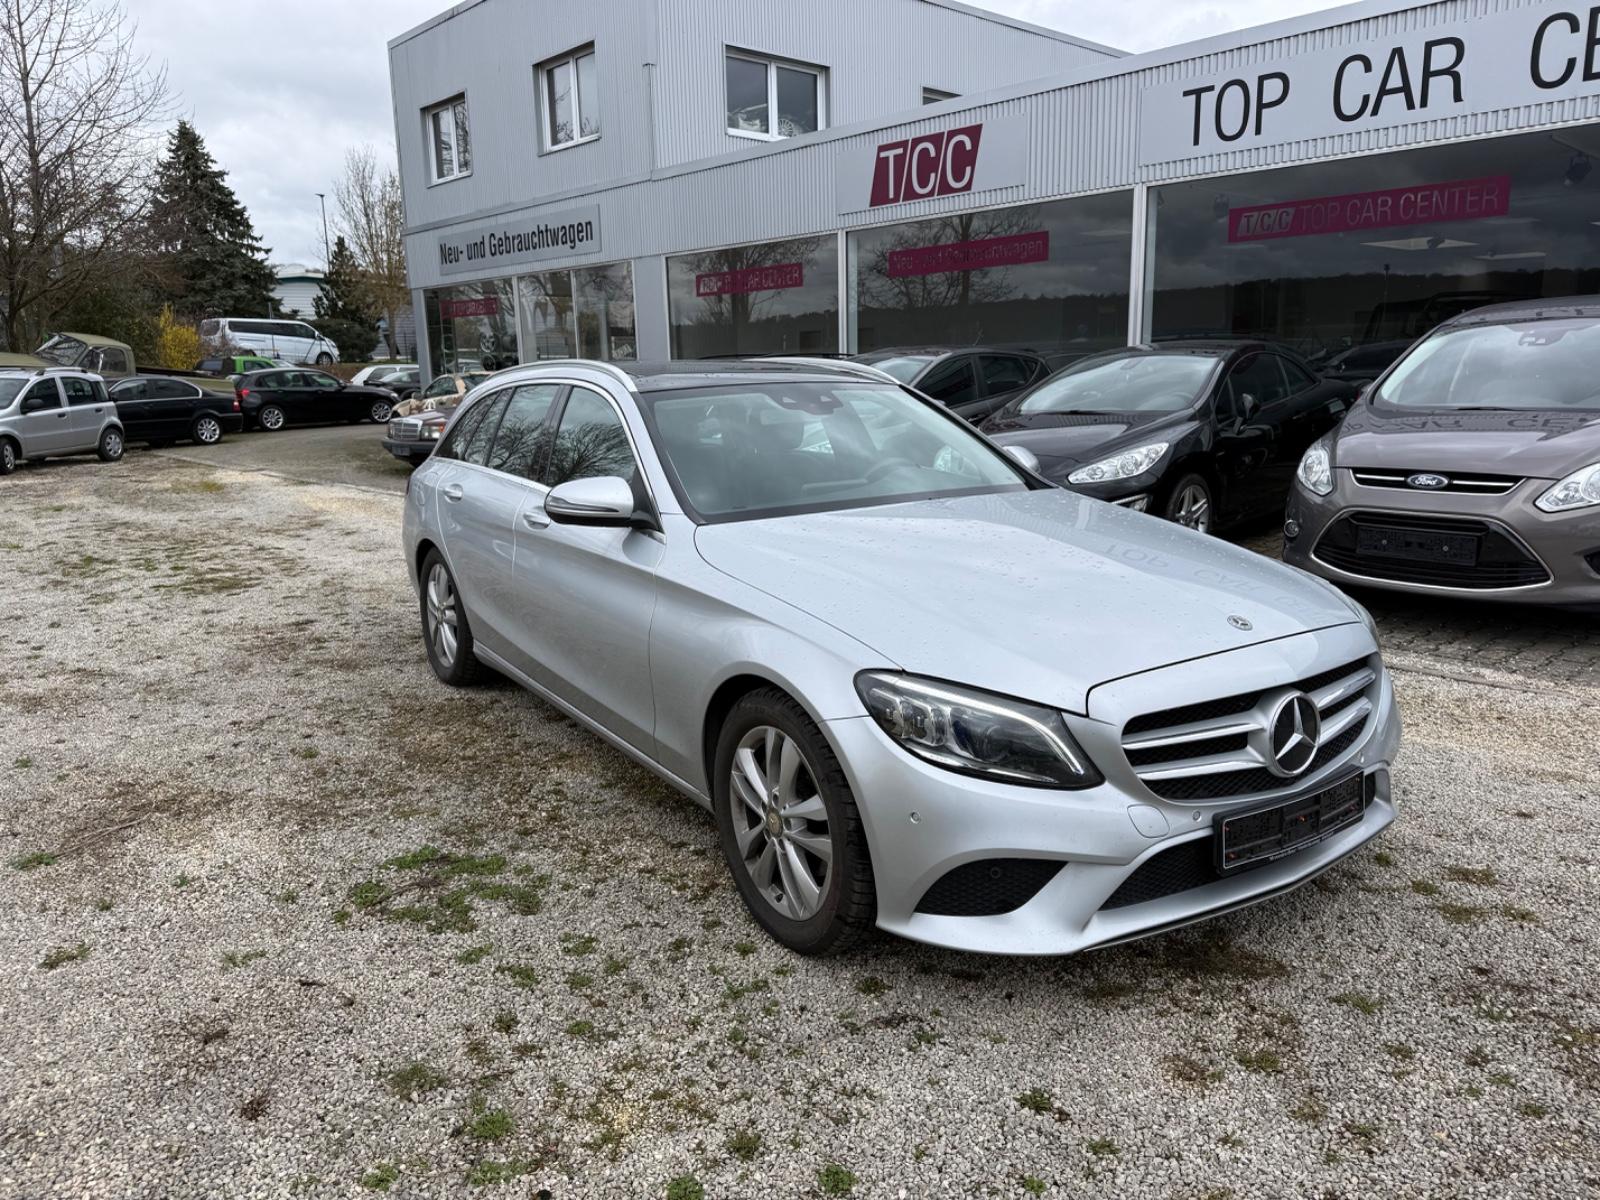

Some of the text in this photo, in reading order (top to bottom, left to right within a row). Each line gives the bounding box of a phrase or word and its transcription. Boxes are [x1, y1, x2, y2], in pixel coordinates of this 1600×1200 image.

[1183, 71, 1290, 146] TOP
[1333, 36, 1465, 122] CAR
[879, 134, 973, 199] TCC
[1300, 203, 1341, 231] TOP
[1346, 196, 1393, 225] CAR
[1400, 184, 1499, 219] CENTER
[440, 220, 594, 265] Neu- und Gebrauchtwagen
[1414, 475, 1438, 486] Ford
